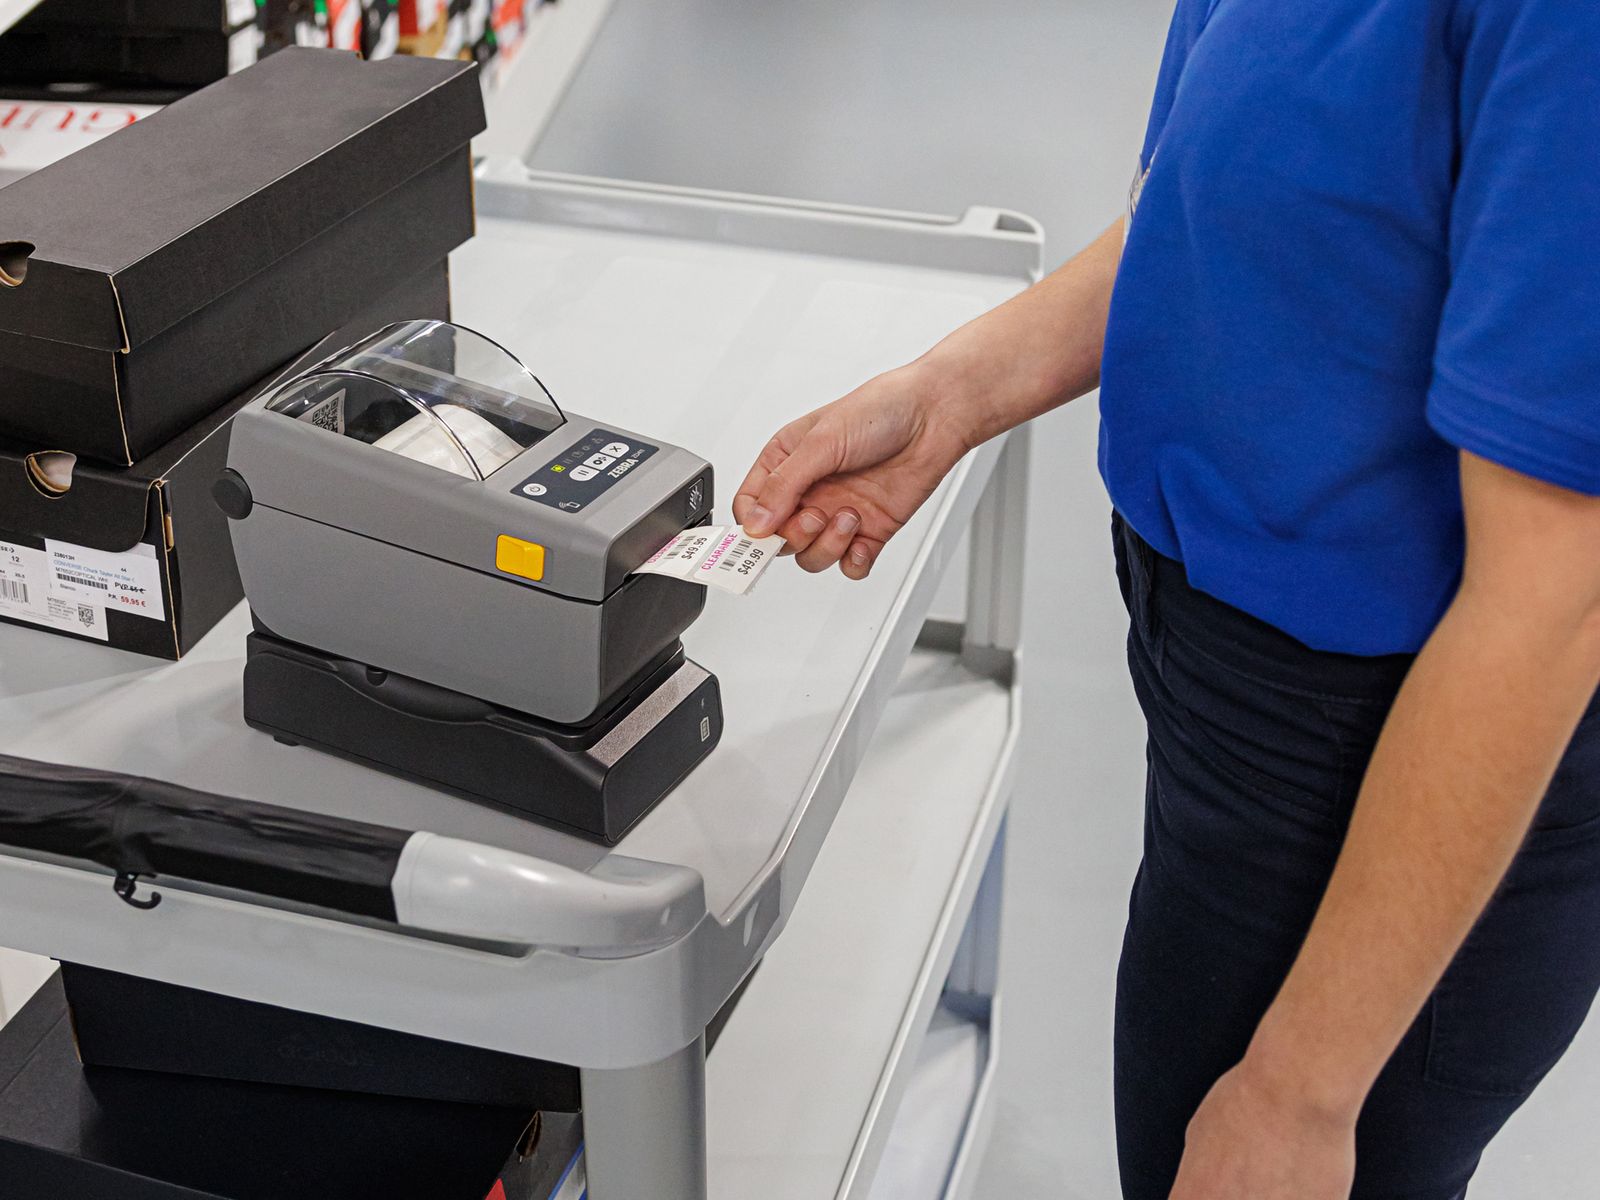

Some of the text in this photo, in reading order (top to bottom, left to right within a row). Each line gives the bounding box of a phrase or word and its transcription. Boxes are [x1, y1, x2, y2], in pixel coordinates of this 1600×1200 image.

[607, 458, 639, 479] ZEBRA
[11, 555, 20, 563] 12
[681, 537, 708, 560] $49.99
[701, 532, 738, 571] CLEARANCE
[737, 548, 764, 575] $49.99
[120, 595, 140, 606] 59,95
